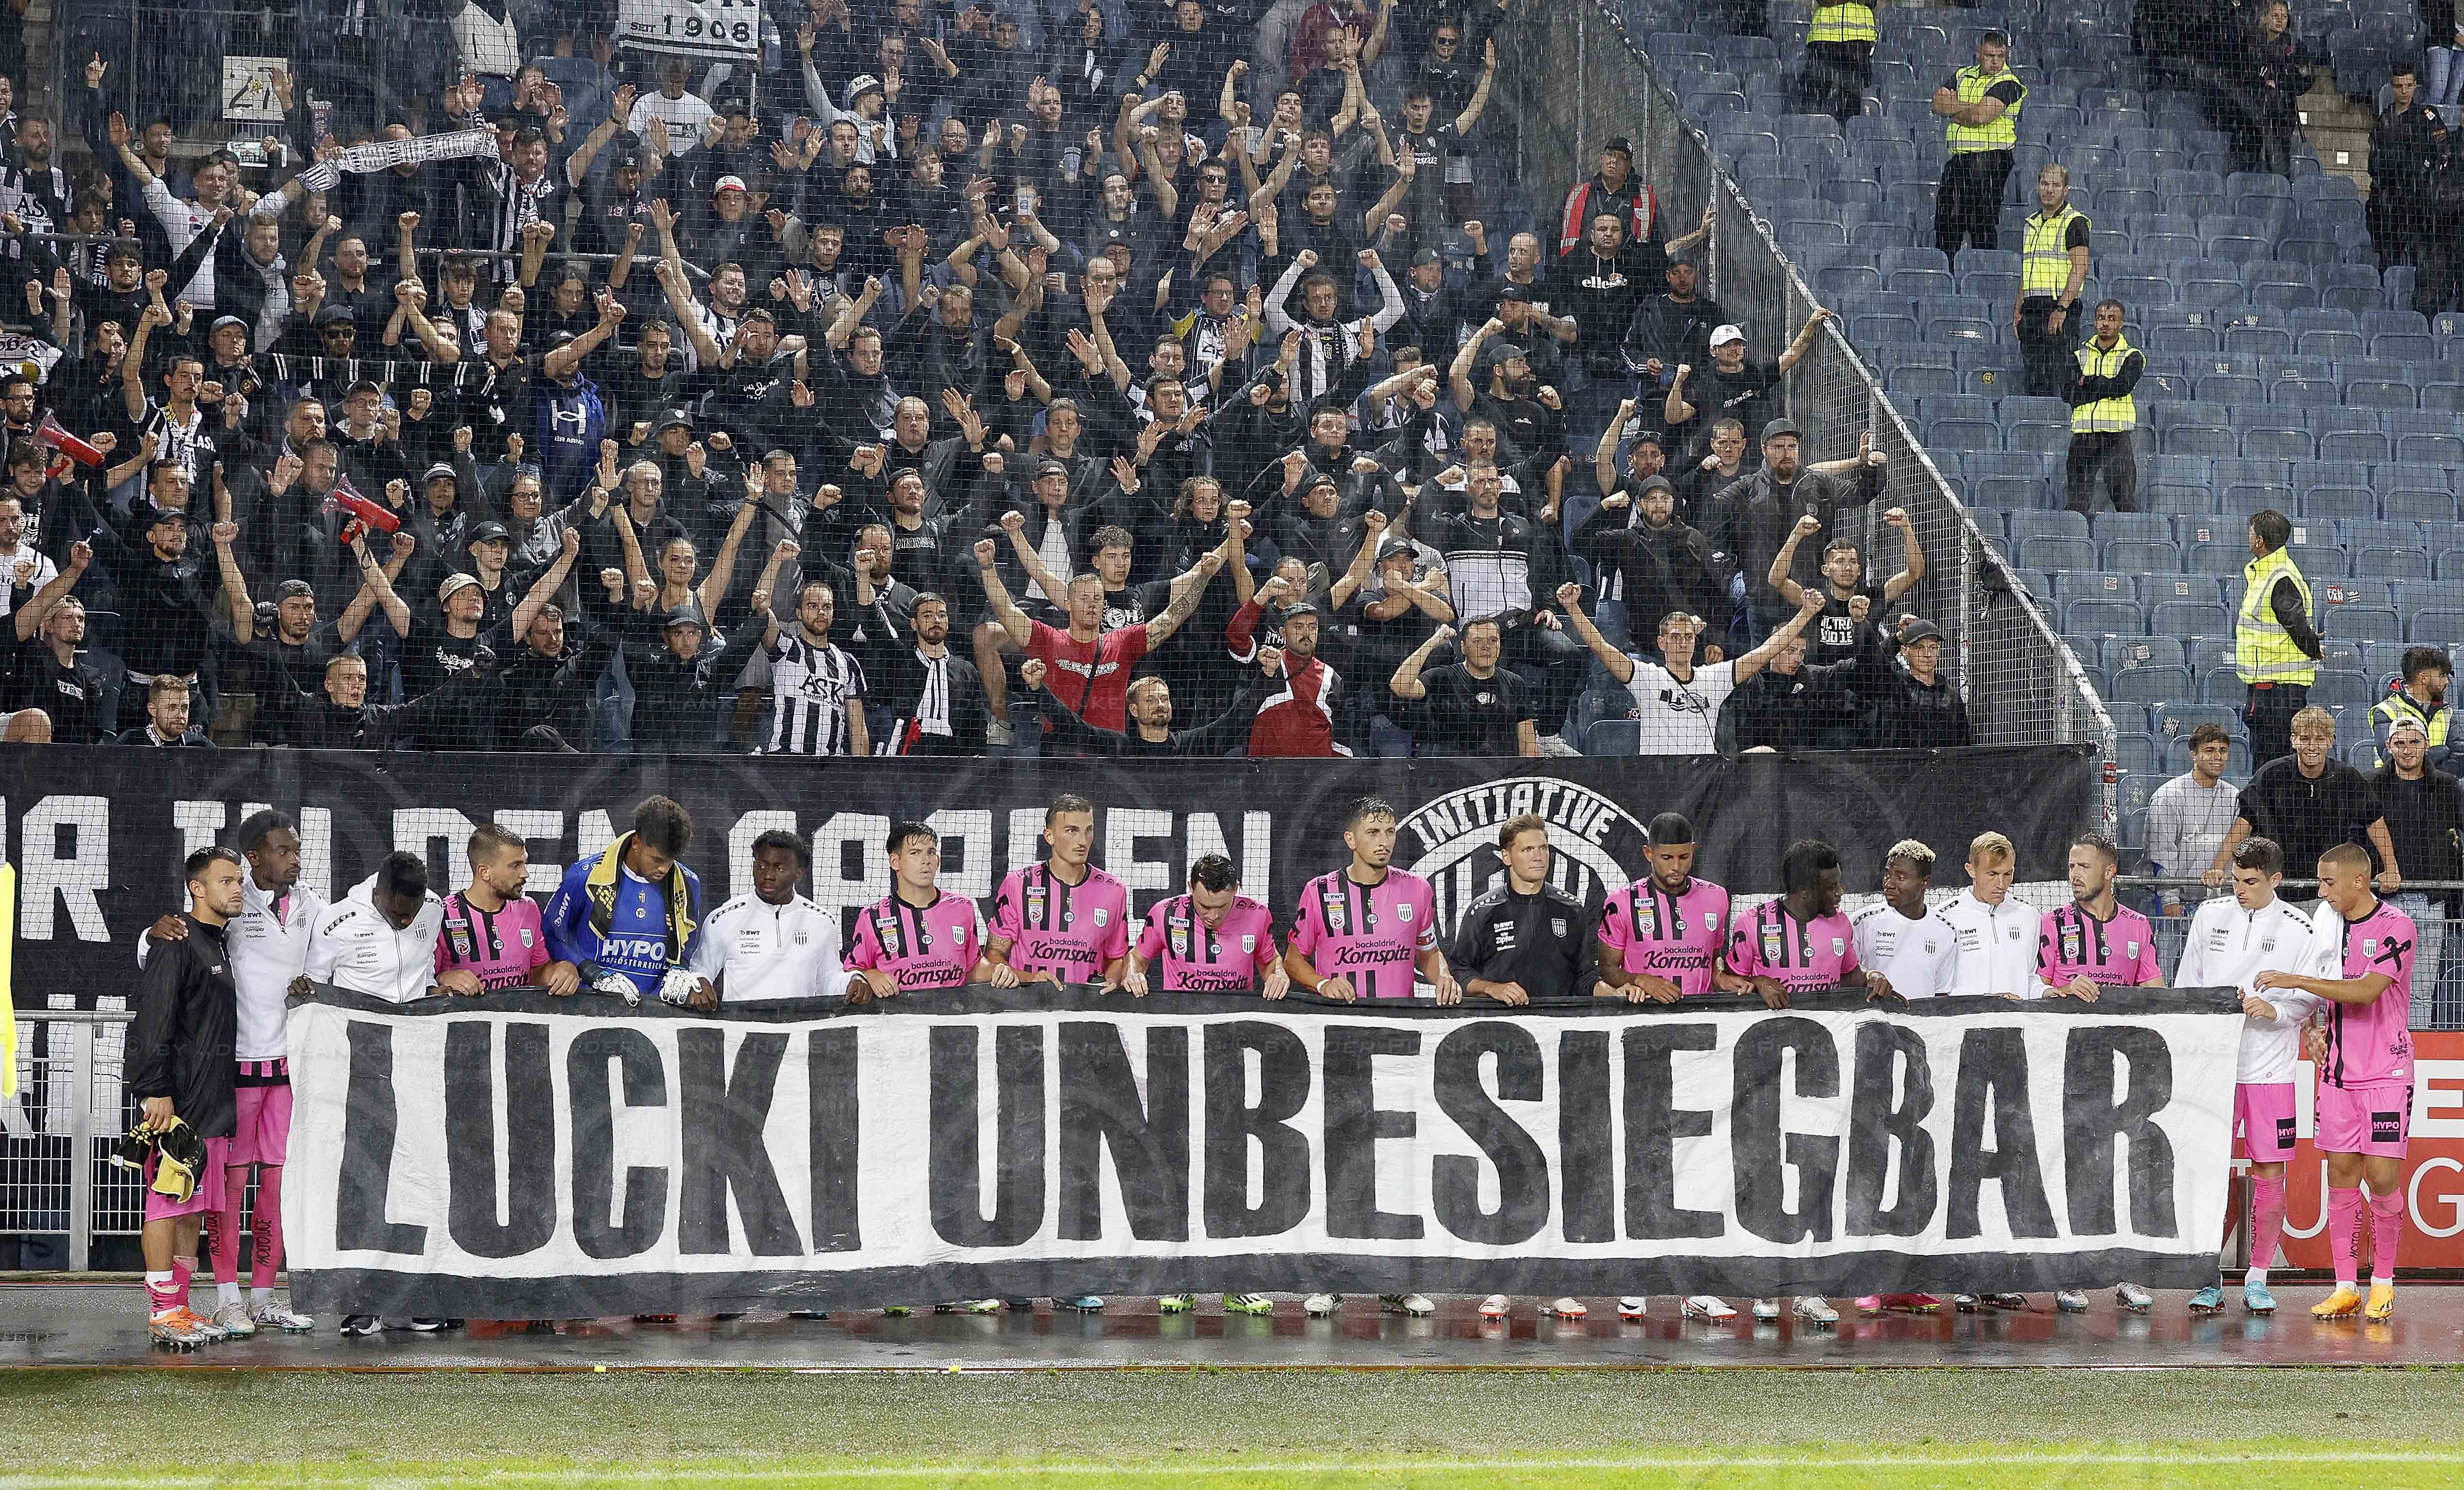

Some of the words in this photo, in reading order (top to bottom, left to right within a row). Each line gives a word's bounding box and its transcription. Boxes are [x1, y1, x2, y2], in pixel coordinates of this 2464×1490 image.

[630, 21, 656, 34] SEIT
[664, 14, 749, 42] 1908
[1582, 276, 1628, 289] ellesse
[798, 673, 844, 706] ASK
[1409, 779, 1620, 851] INITIATIVE
[0, 795, 111, 942] R
[559, 892, 571, 918] BWT
[601, 939, 666, 961] HYPO
[1049, 937, 1087, 947] backaldrin
[1355, 939, 1395, 948] backaldrin
[1495, 935, 1515, 944] Zipfer
[1029, 940, 1098, 965] Kornspitz
[1334, 945, 1411, 966] Kornspitz
[483, 964, 520, 975] backaldrin
[893, 964, 964, 986] Kornspitz
[911, 959, 951, 970] backaldrin
[1197, 969, 1237, 977] backaldrin
[1791, 972, 1829, 981] backaldrin
[2088, 971, 2123, 980] backaldrin
[335, 1021, 860, 1260] LUCKI
[930, 1017, 2178, 1247] UNBESIEGBAR
